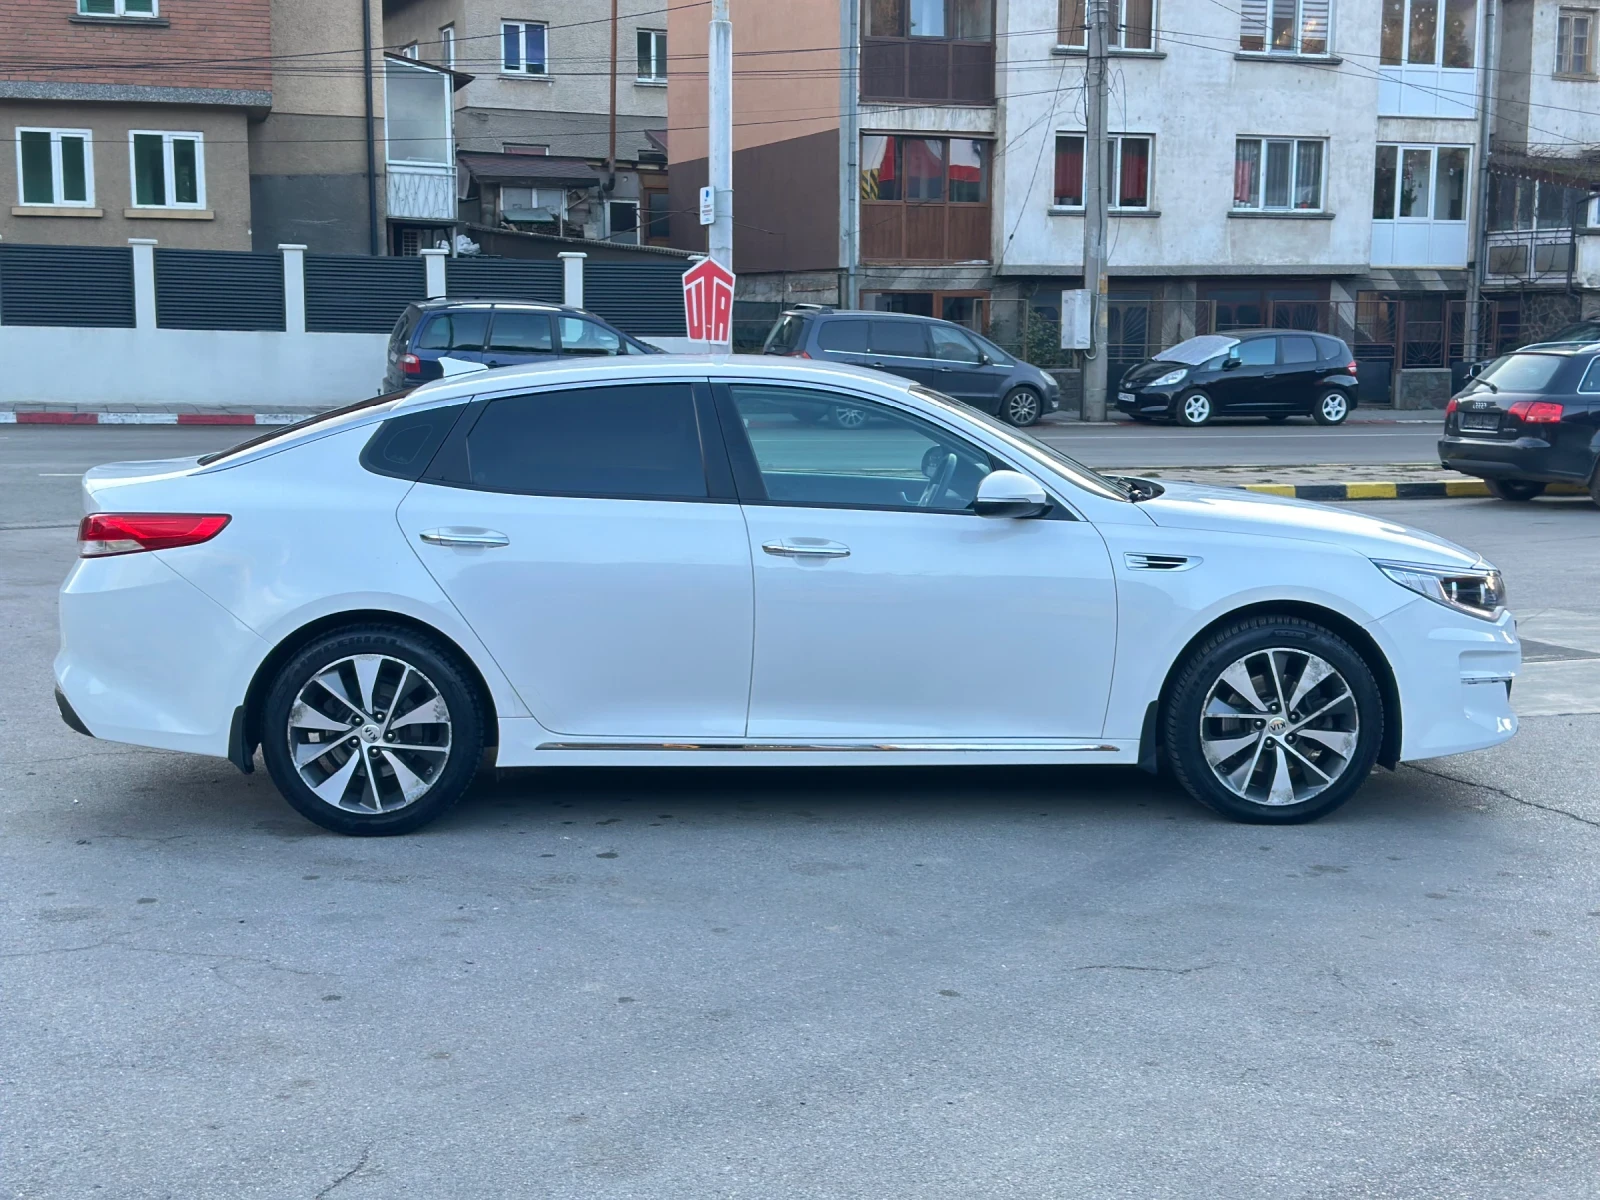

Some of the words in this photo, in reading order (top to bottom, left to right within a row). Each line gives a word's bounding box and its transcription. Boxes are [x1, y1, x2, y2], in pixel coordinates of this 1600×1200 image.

[684, 259, 734, 342] UTA
[1270, 722, 1286, 731] KIA
[364, 727, 378, 741] KIA
